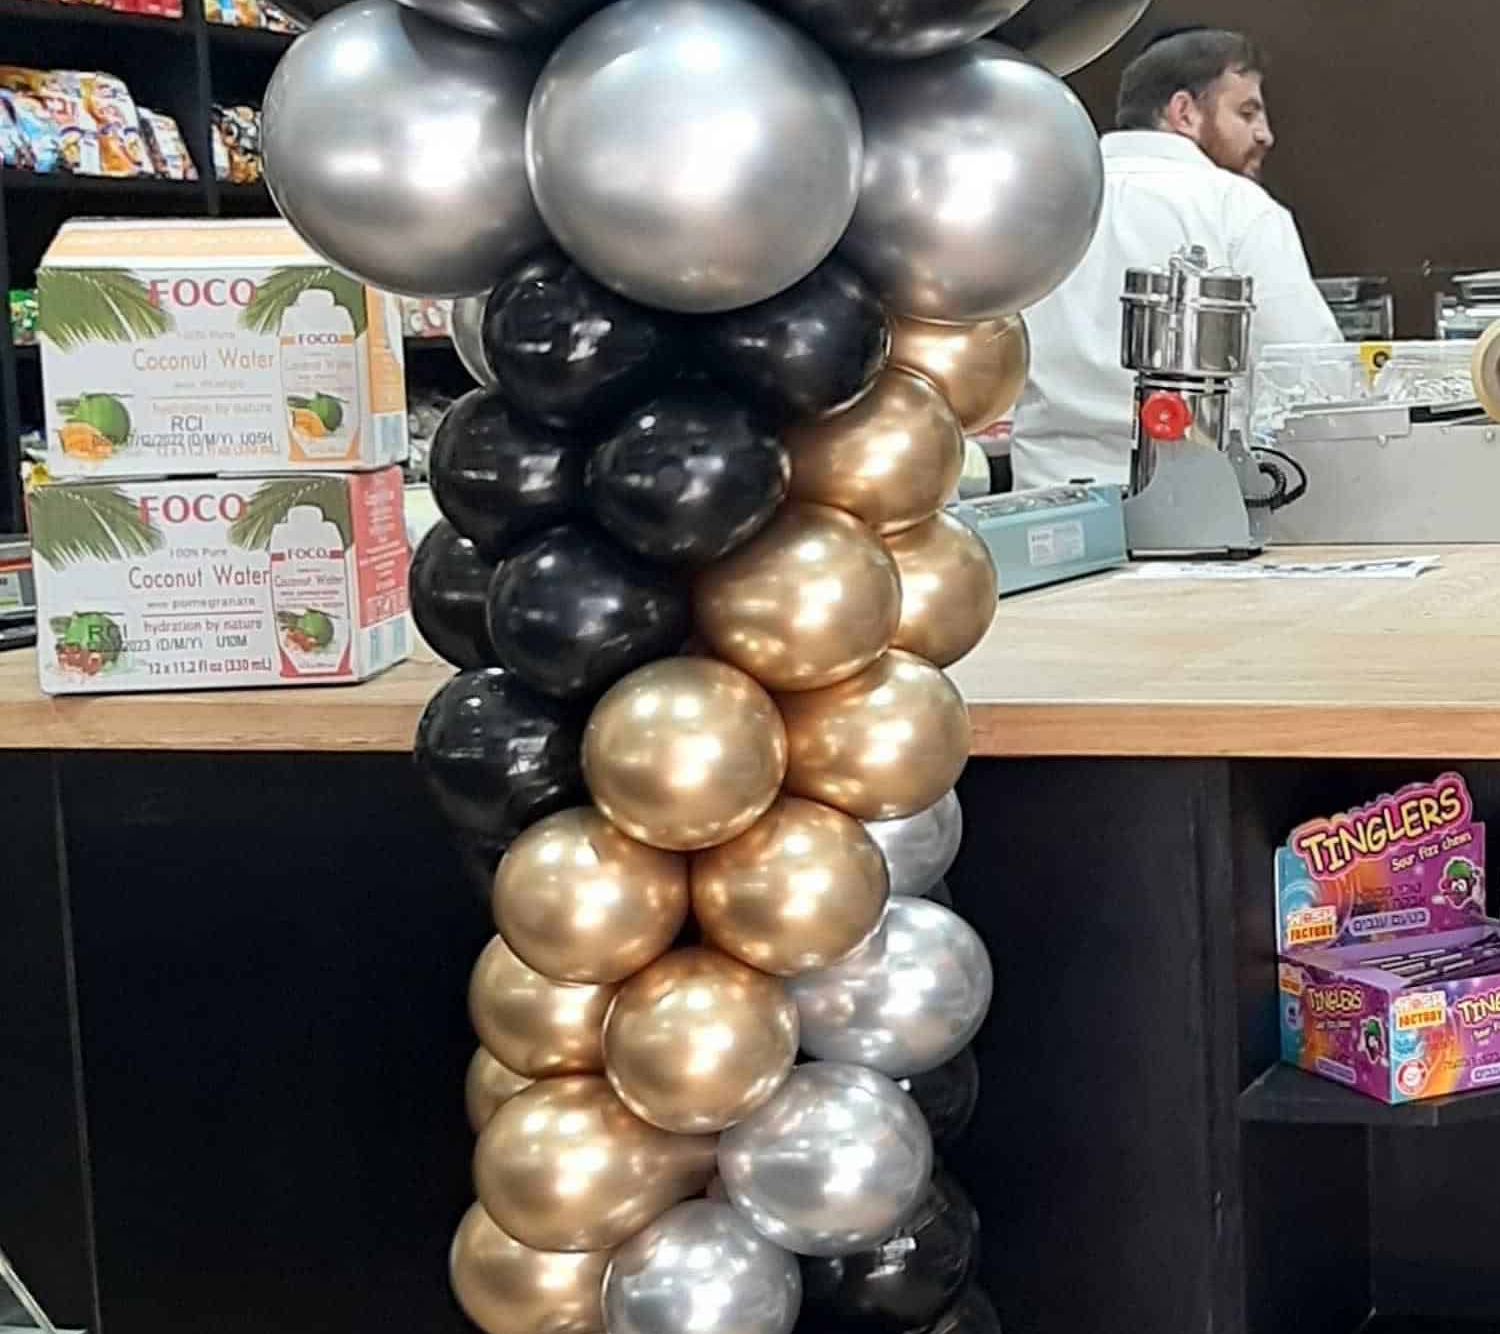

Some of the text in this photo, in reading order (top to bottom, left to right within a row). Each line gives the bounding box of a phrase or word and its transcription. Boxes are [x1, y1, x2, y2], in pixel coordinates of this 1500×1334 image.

[150, 277, 258, 308] FOCO
[132, 347, 274, 372] Coconut Water
[171, 415, 204, 433] RCI
[139, 494, 246, 525] FOCO
[128, 564, 271, 591] Coconut Water
[143, 618, 263, 634] hydration by nature
[1301, 786, 1463, 873] TINGLERS
